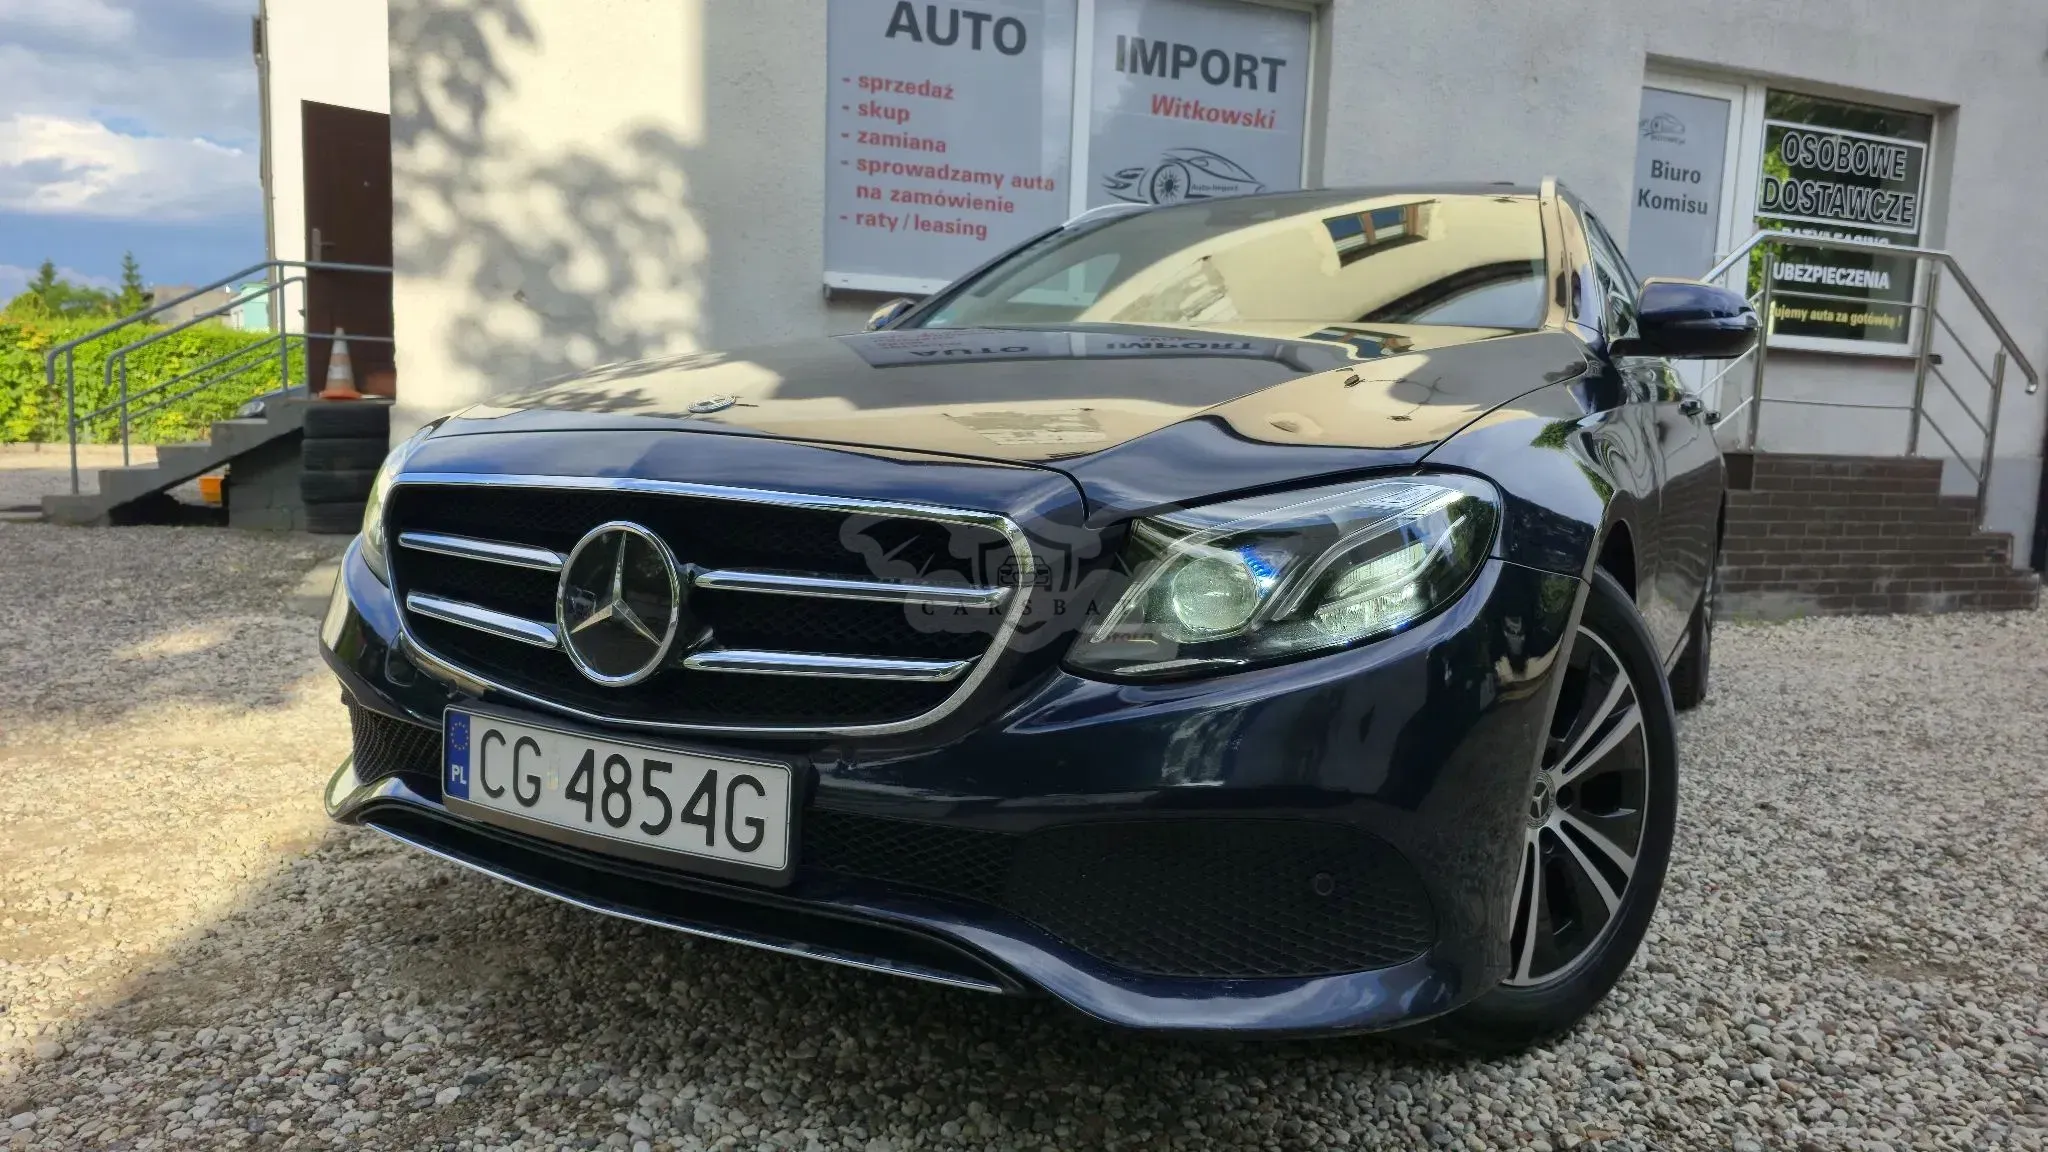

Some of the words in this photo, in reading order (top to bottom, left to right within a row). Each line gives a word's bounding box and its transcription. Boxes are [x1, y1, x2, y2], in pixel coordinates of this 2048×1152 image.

[885, 0, 1027, 56] AUTO
[1115, 35, 1287, 93] IMPORT
[857, 73, 955, 101] sprzedaż
[857, 102, 911, 126] skup
[1150, 94, 1276, 129] Witkowski
[857, 130, 947, 154] zamiana
[1780, 131, 1908, 182] OSOBOWE
[856, 157, 1006, 191] sprowadzamy
[1010, 173, 1056, 193] auta
[1650, 159, 1702, 185] Biuro
[856, 184, 882, 200] na
[890, 186, 1015, 214] zamówienie
[1637, 187, 1708, 215] Komisu
[1760, 175, 1917, 226] DOSTAWCZE
[856, 212, 899, 233] raty
[913, 217, 988, 241] leasing
[1772, 262, 1891, 290] UBEZPIECZENIA
[1810, 309, 1835, 322] auta
[1836, 312, 1849, 323] za
[451, 764, 468, 785] PL
[479, 728, 542, 808] CG
[564, 747, 766, 853] 4854G
